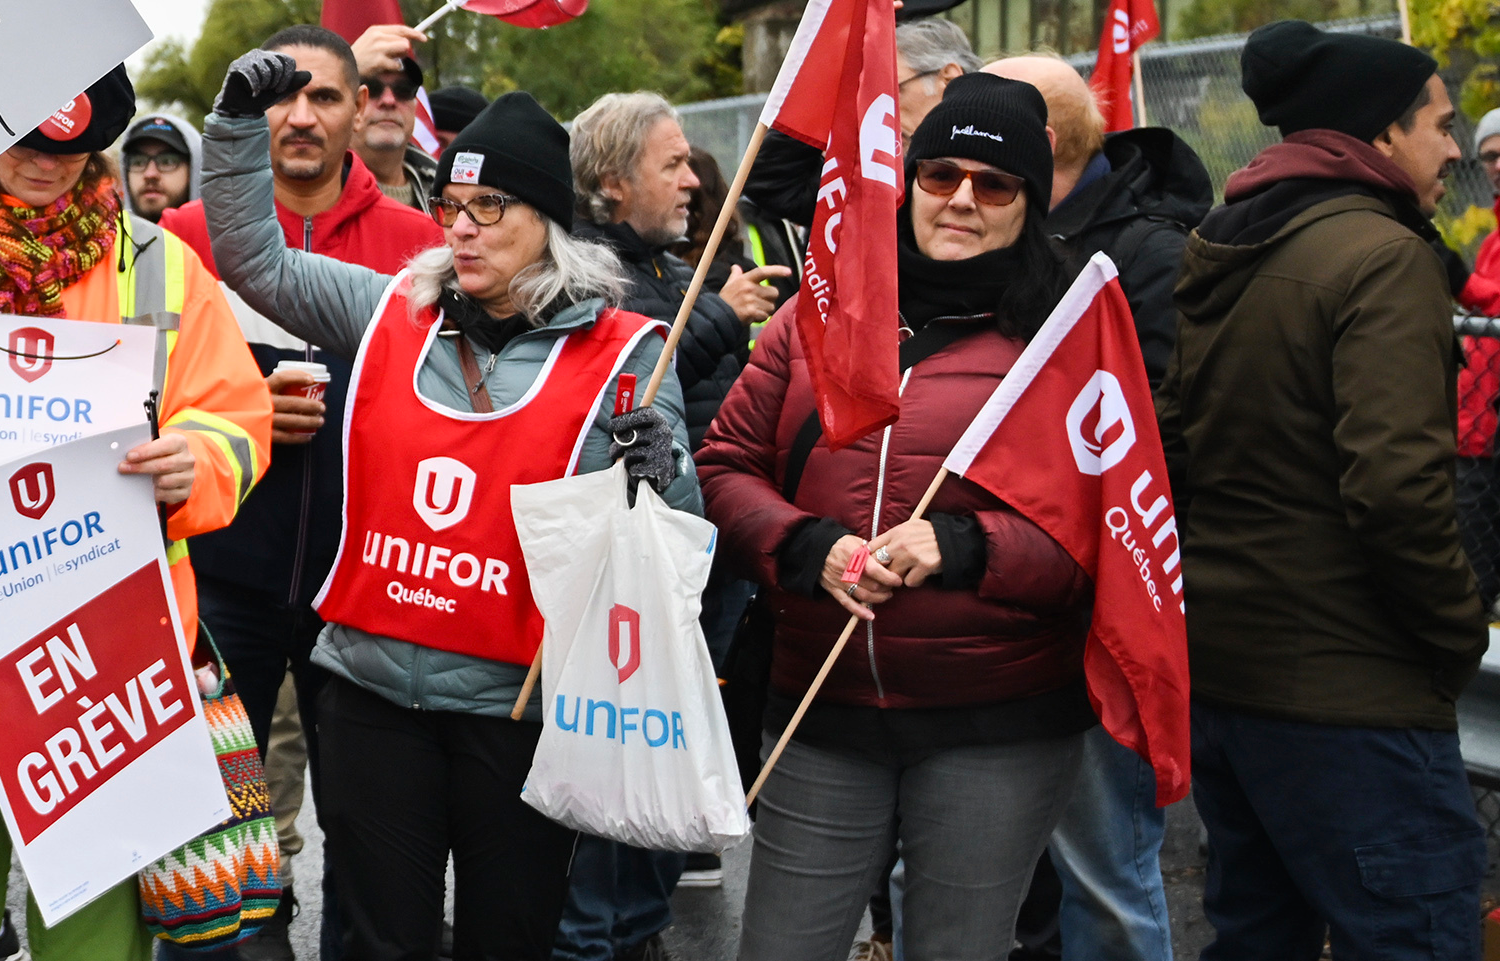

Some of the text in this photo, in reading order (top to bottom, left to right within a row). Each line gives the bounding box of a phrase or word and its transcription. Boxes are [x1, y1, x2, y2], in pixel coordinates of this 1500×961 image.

[386, 581, 457, 614] Québec
[1105, 505, 1162, 613] Québec
[15, 622, 98, 715] EN
[17, 657, 185, 816] GRÈVE
